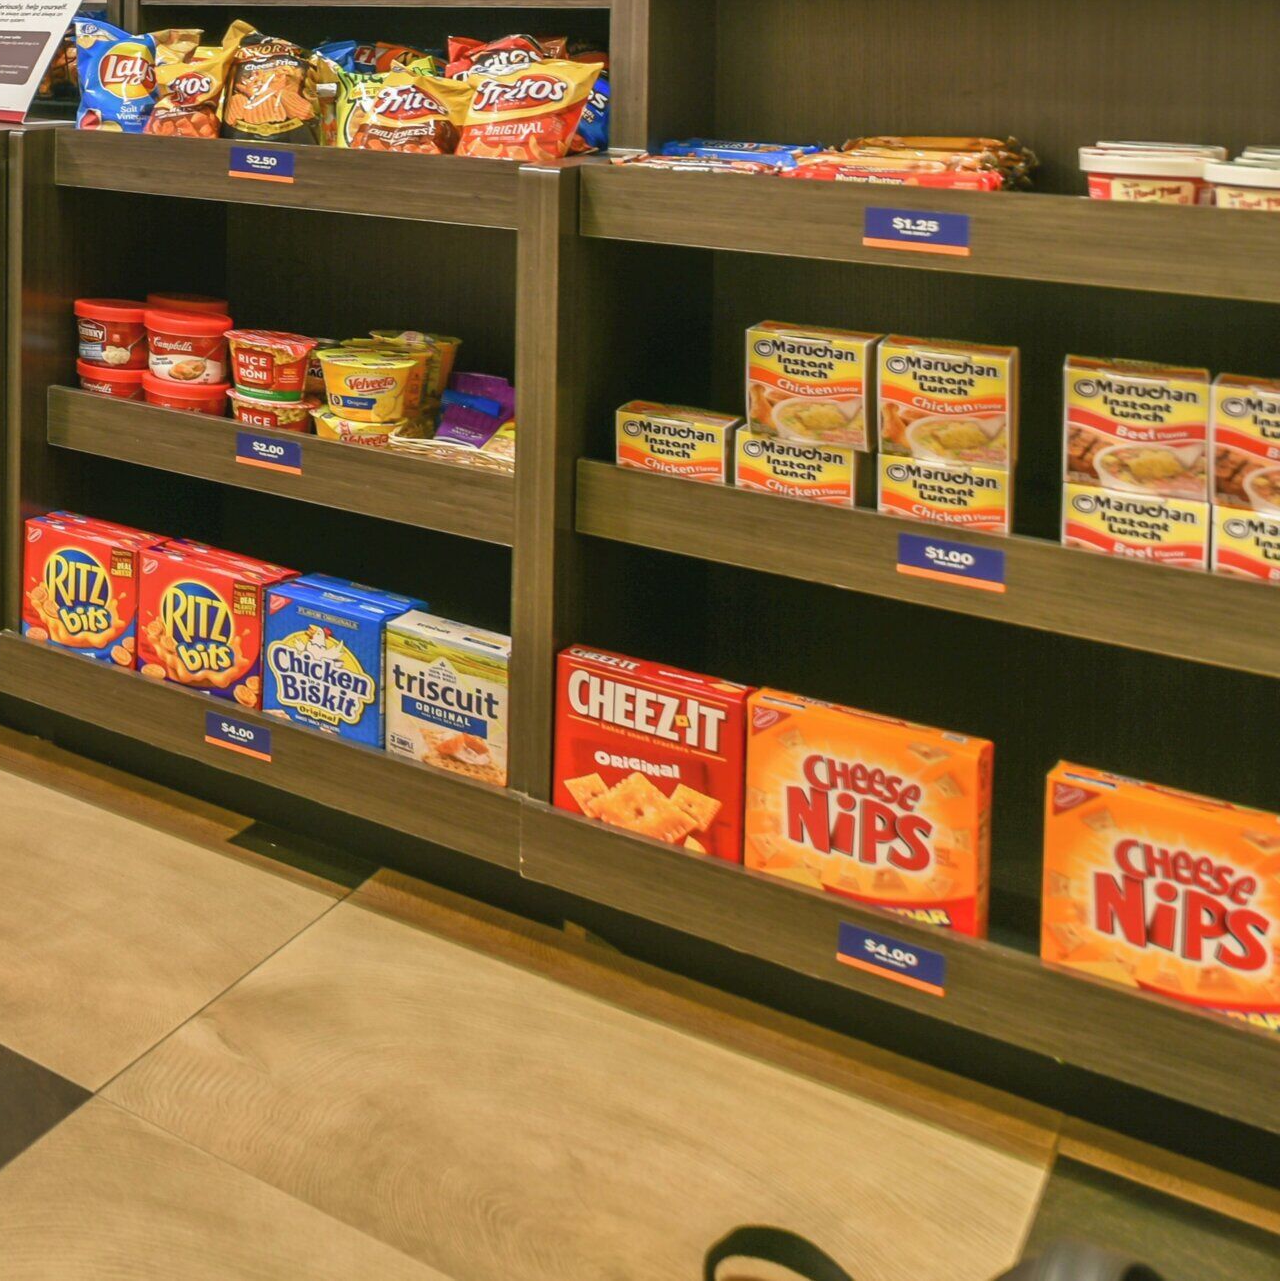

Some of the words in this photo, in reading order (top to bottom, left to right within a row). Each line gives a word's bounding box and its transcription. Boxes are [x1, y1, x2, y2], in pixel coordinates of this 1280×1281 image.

[276, 58, 298, 68] Fries
[474, 79, 568, 110] Fritos
[120, 105, 138, 114] Salt
[485, 122, 543, 136] ORIGINAL
[246, 155, 277, 166] $2.50
[892, 216, 939, 233] $1.25
[153, 336, 193, 351] Campbell's
[771, 339, 856, 362] Maruchan
[238, 354, 267, 367] RICE
[777, 355, 834, 371] Instant
[905, 355, 999, 378] Maruchan
[783, 364, 828, 379] Lunch
[912, 371, 975, 388] Instant
[346, 376, 396, 392] Velveeta
[776, 378, 833, 396] Chicken
[919, 382, 968, 397] Lunch
[1096, 379, 1198, 404] Maruchan
[911, 396, 973, 414] Chicken
[1103, 395, 1172, 413] Instant
[242, 413, 271, 427] RICE
[1110, 407, 1164, 423] Lunch
[639, 420, 717, 444] Maruchan
[1116, 425, 1156, 440] Beef
[252, 441, 284, 456] $2.00
[644, 433, 696, 452] Instant
[650, 444, 691, 460] Lunch
[644, 457, 695, 474] Chicken
[925, 546, 975, 566] $1.00
[1113, 542, 1153, 558] Beef
[48, 554, 105, 607] RITZ
[59, 606, 110, 634] bits
[166, 587, 228, 644] RITZ
[178, 643, 232, 671] bits
[273, 647, 368, 697] Chicken
[280, 674, 356, 717] Biskit
[392, 663, 499, 719] triscuit
[299, 705, 337, 723] Original
[415, 702, 471, 726] ORIGINAL
[567, 670, 726, 753] CHEEZ-IT
[221, 722, 254, 740] $4.00
[864, 939, 918, 967] $4.00
